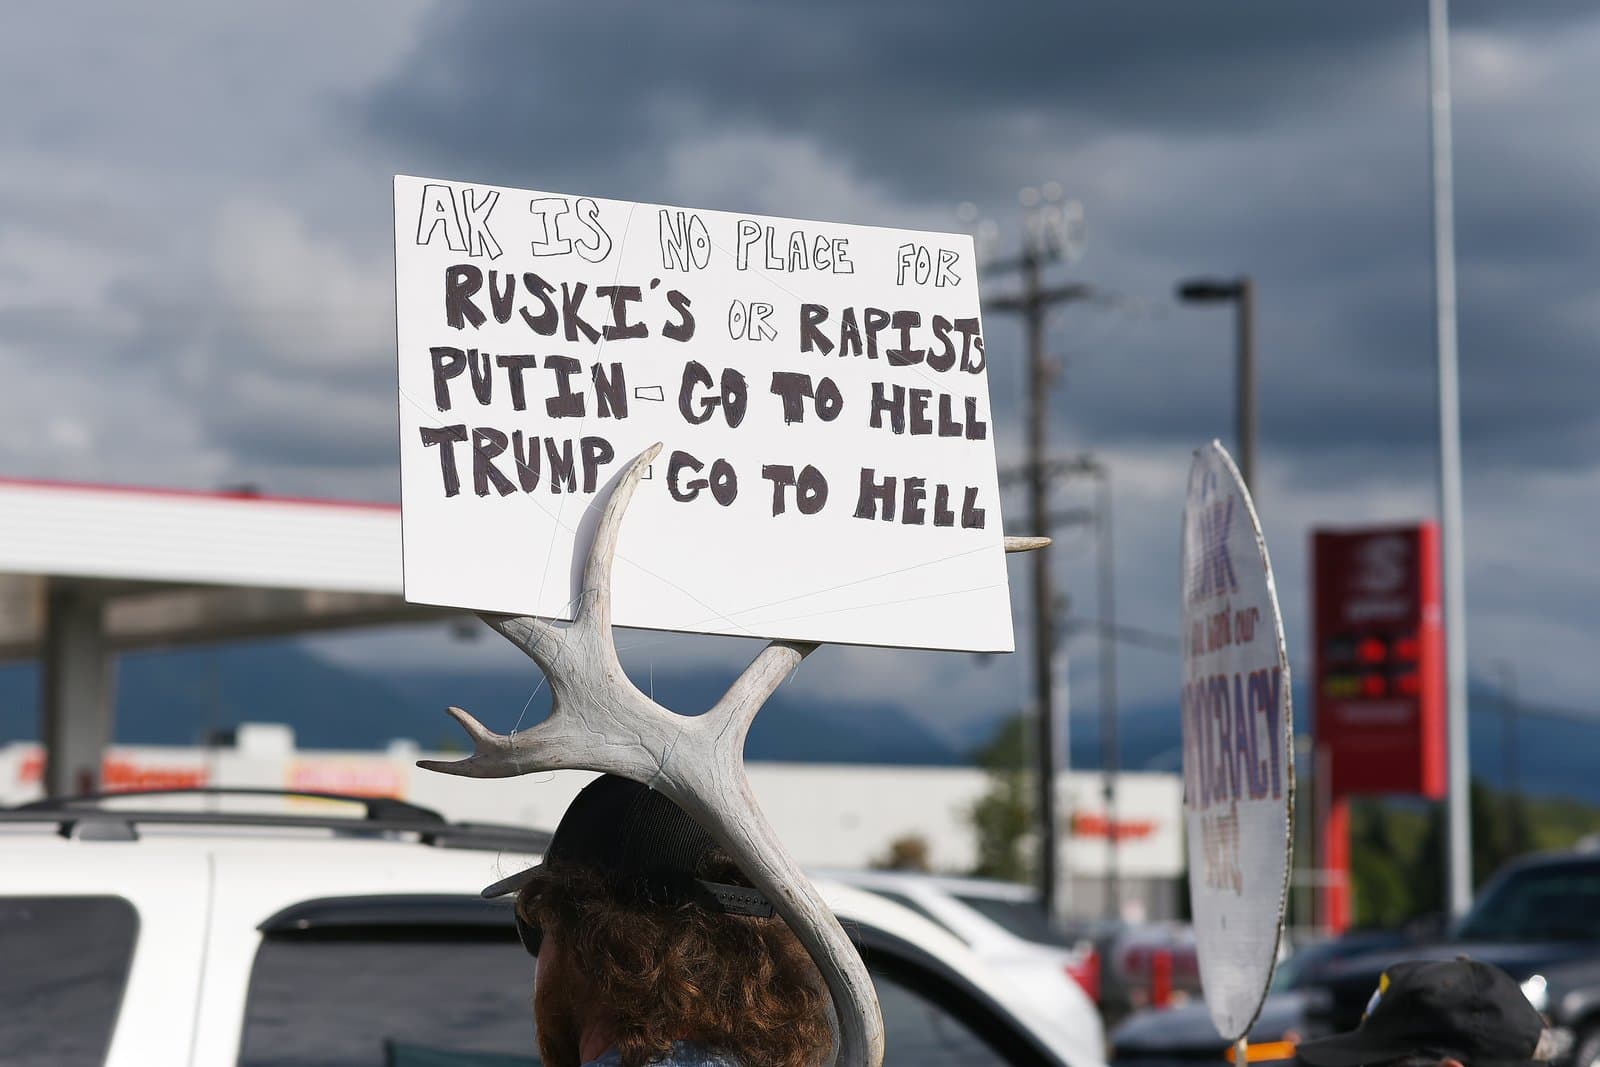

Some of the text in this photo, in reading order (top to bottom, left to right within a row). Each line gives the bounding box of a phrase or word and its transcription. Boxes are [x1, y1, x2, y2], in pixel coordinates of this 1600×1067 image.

[415, 184, 962, 288] AK IS NO PLACE FOR
[444, 263, 987, 375] RUSKI'S OR RAPISTS
[678, 359, 748, 429] GO
[769, 371, 844, 427] TO
[869, 381, 987, 441] HELL
[418, 424, 986, 530] TRUMP GO TO HELL
